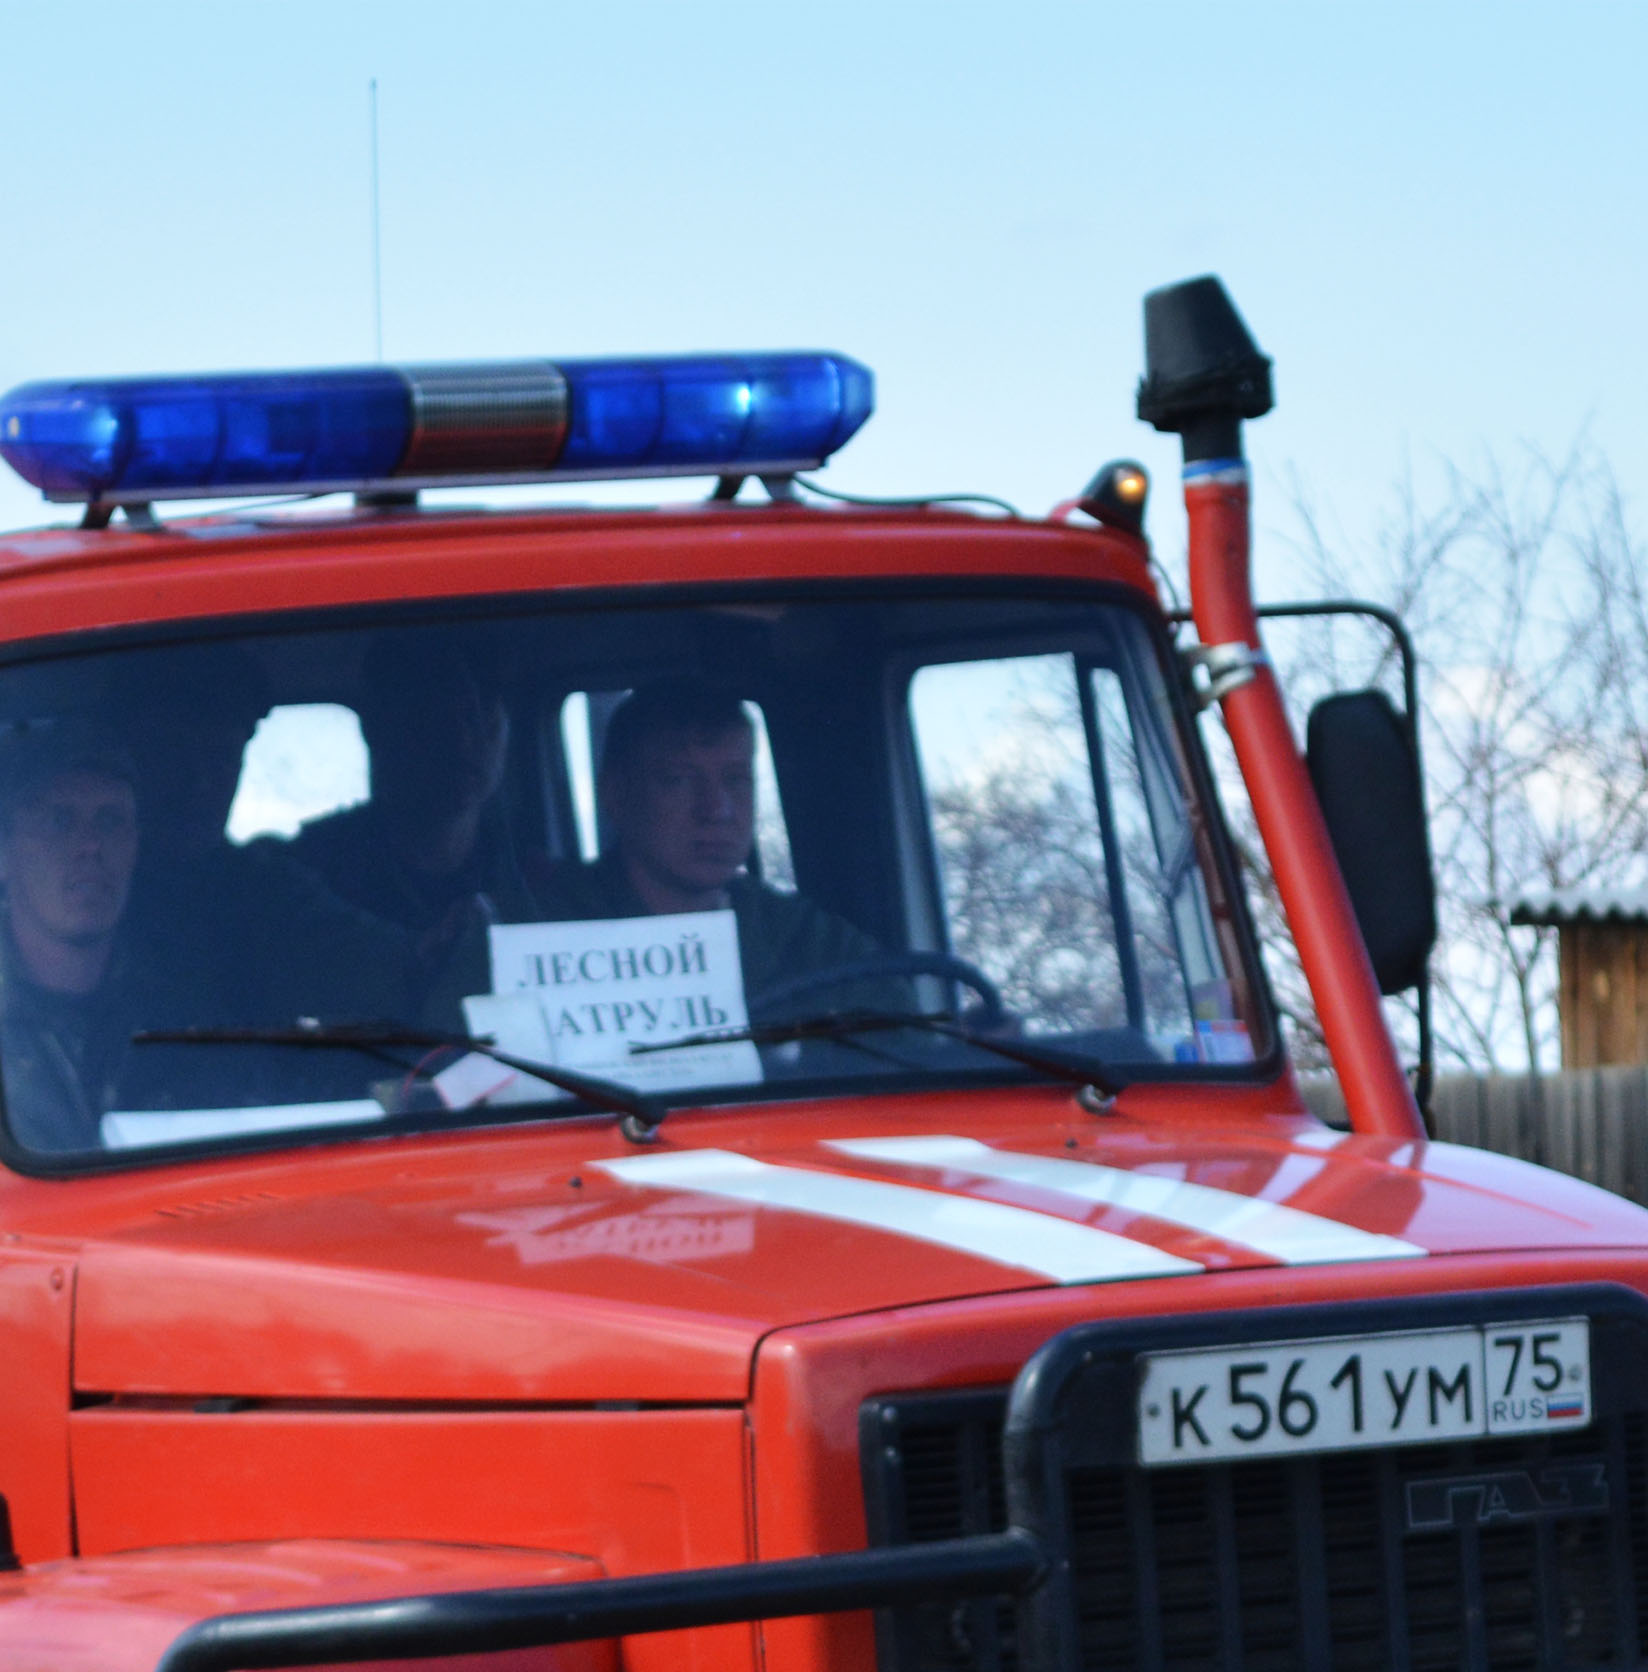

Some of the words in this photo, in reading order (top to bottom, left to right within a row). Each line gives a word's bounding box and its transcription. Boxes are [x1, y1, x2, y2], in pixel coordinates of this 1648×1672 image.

[517, 932, 708, 988] ЛЕСНОЙ
[554, 995, 729, 1037] АТРУЛЬ
[1171, 1354, 1474, 1448] К561УМ
[1494, 1333, 1565, 1397] 75
[1492, 1397, 1544, 1422] RUS
